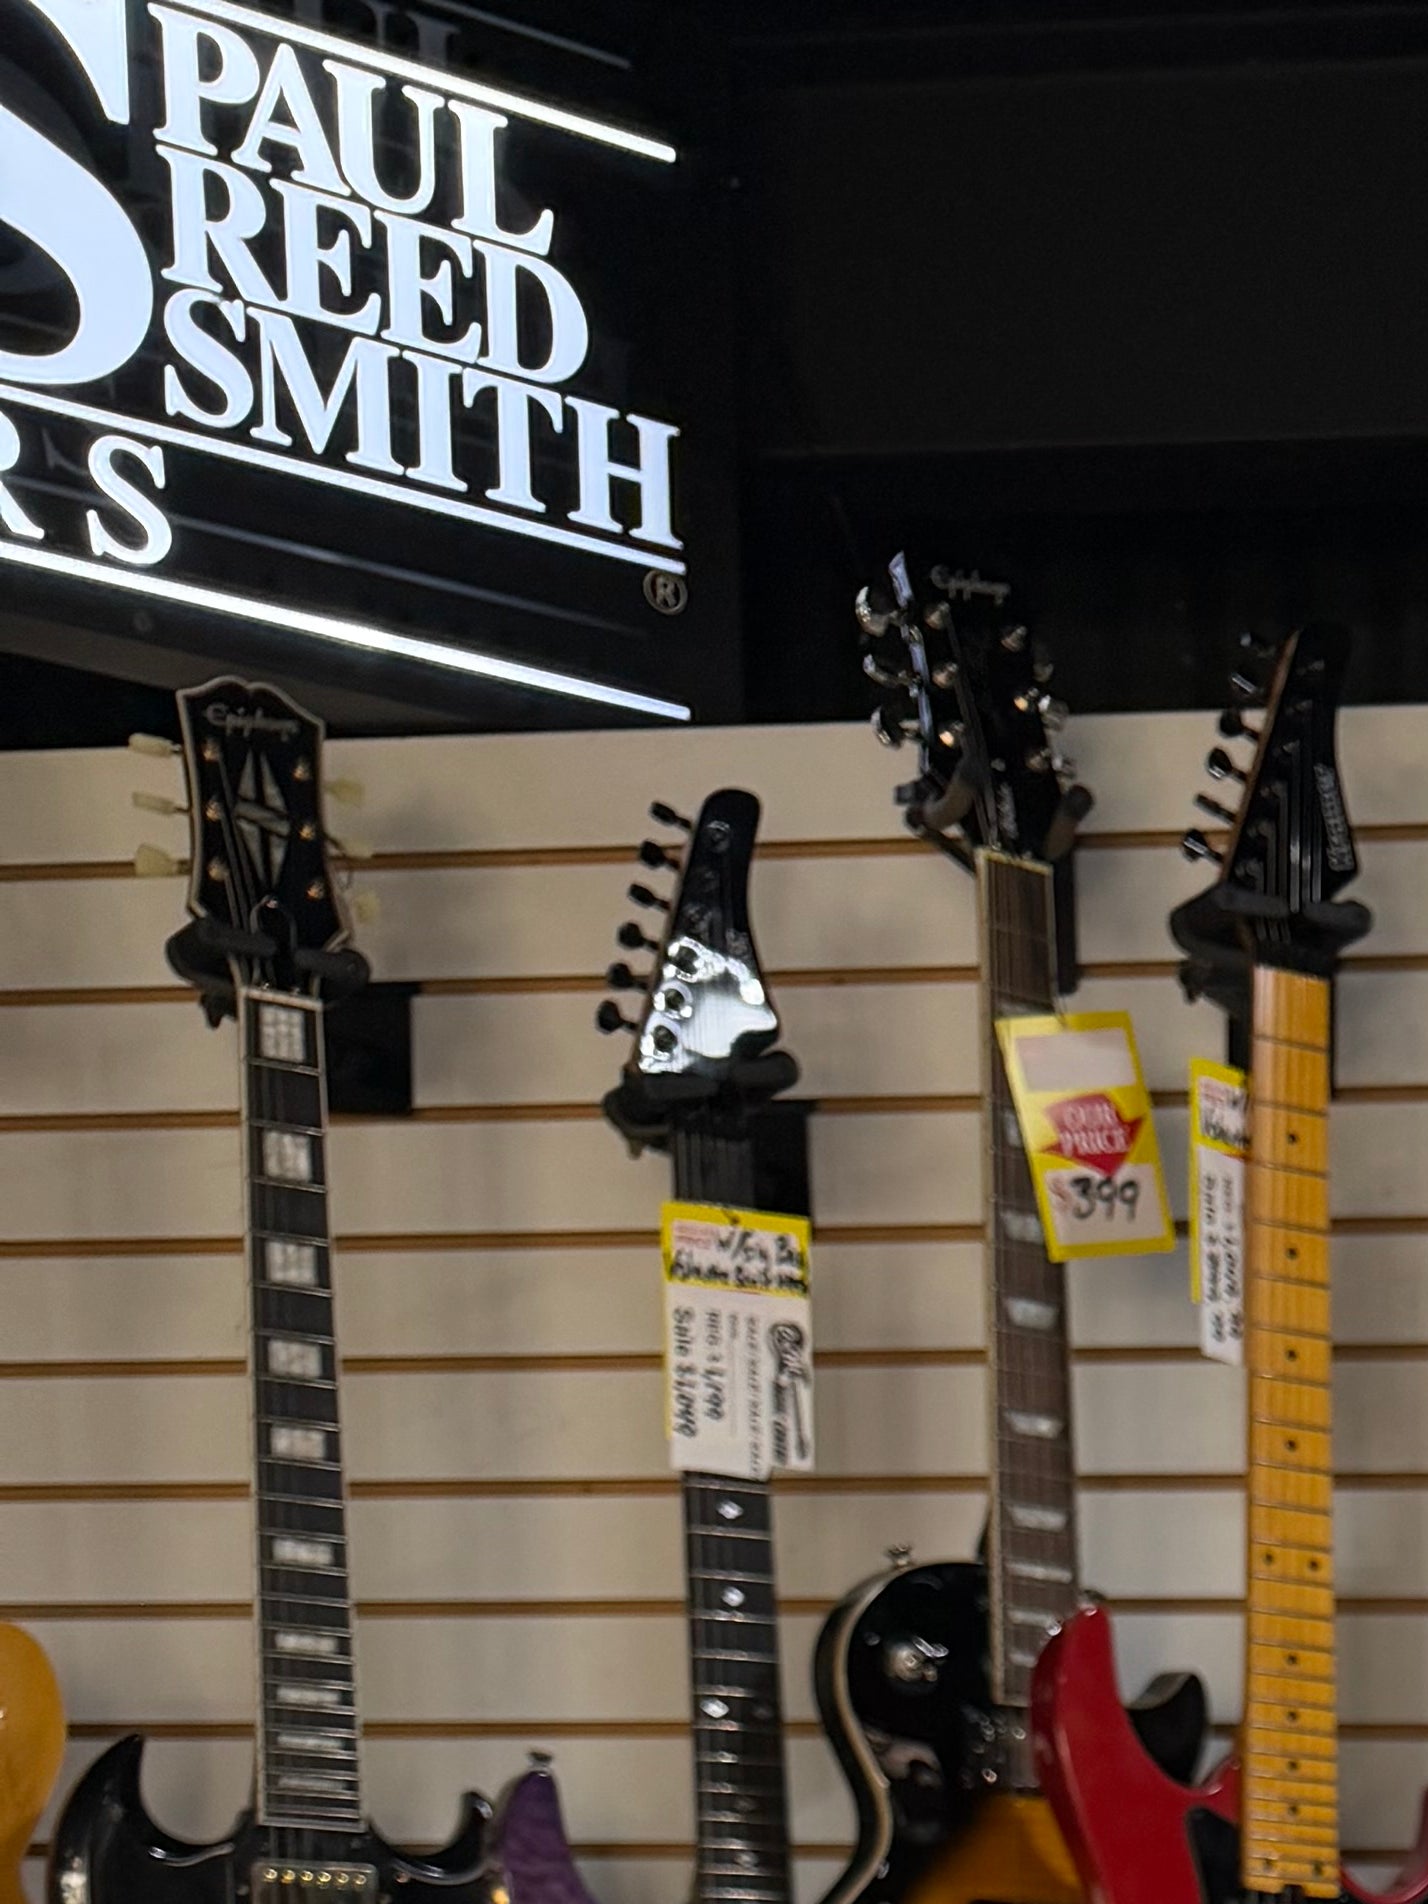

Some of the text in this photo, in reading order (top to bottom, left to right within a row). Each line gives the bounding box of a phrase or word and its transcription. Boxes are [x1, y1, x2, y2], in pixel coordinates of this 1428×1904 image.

[148, 2, 555, 256] PAUL
[154, 145, 590, 385] REED
[162, 287, 684, 552] SMITH
